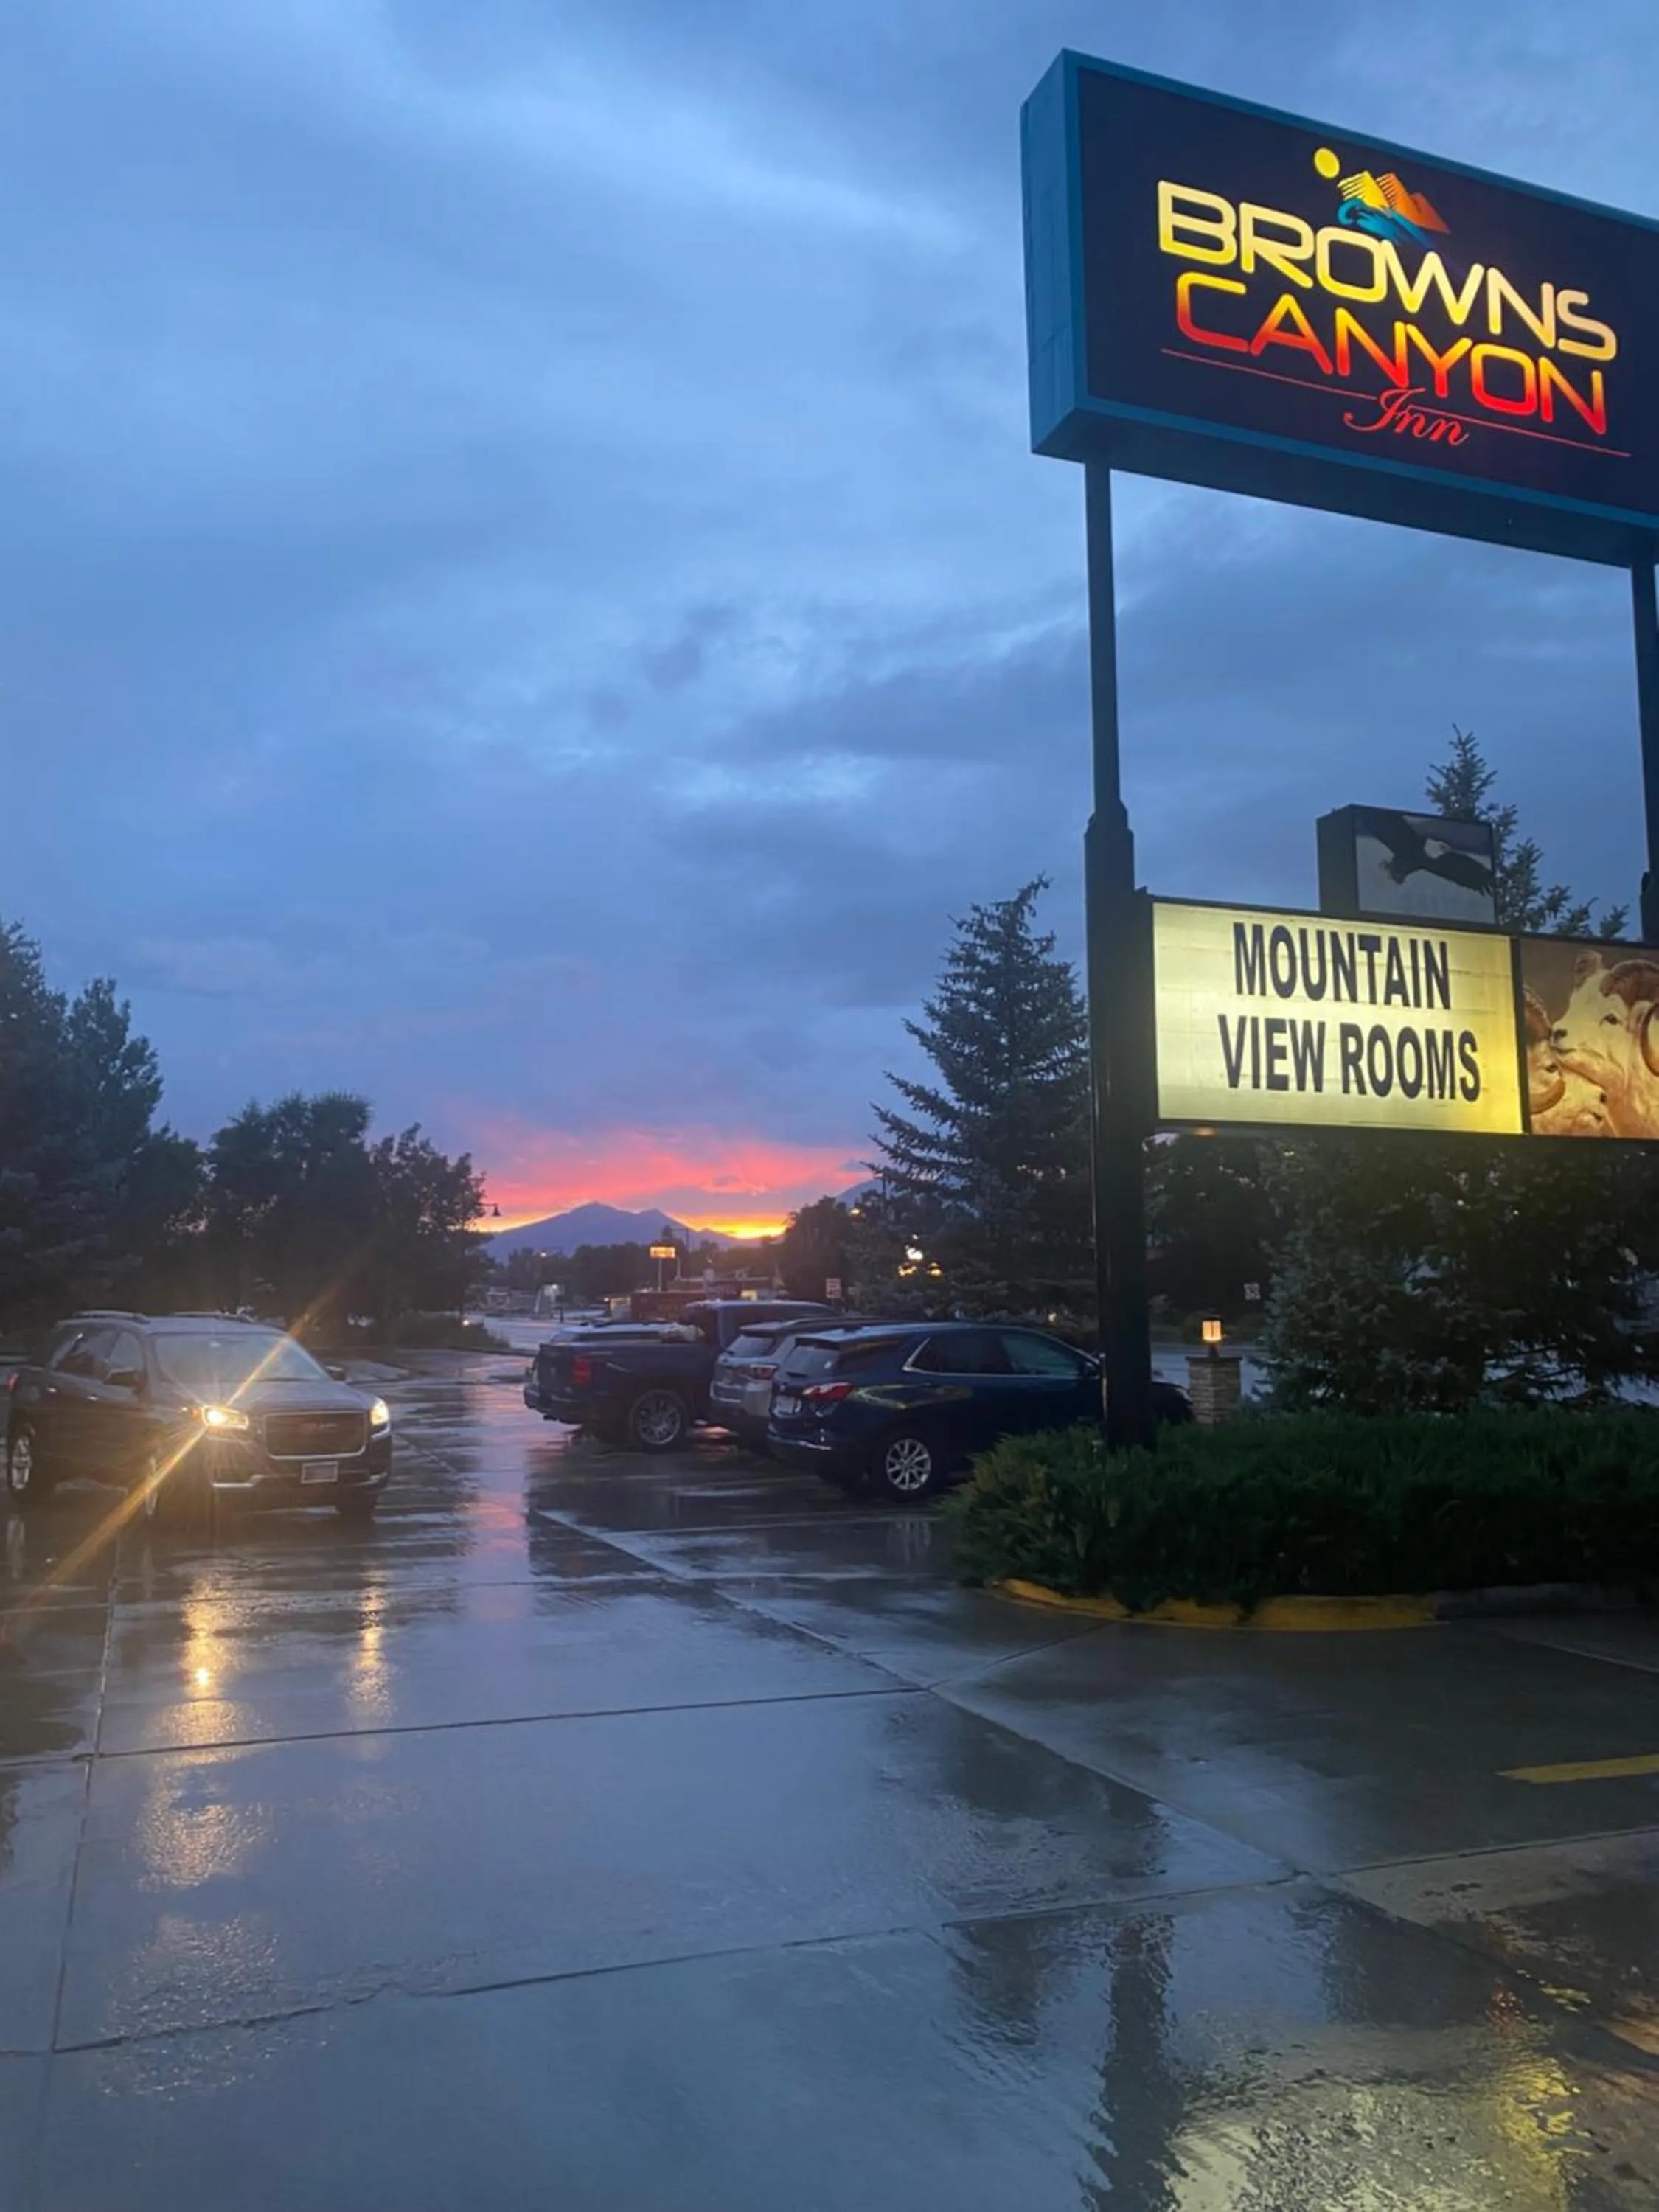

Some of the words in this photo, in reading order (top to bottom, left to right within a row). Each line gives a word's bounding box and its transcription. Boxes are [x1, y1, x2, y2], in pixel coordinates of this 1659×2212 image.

[1157, 179, 1618, 361] BROWNS
[1175, 271, 1607, 435] CANYON
[1343, 386, 1470, 446] Inn
[1232, 921, 1452, 1011] MOUNTAIN
[1217, 1014, 1326, 1094] VIEW
[1340, 1023, 1481, 1103] ROOMS
